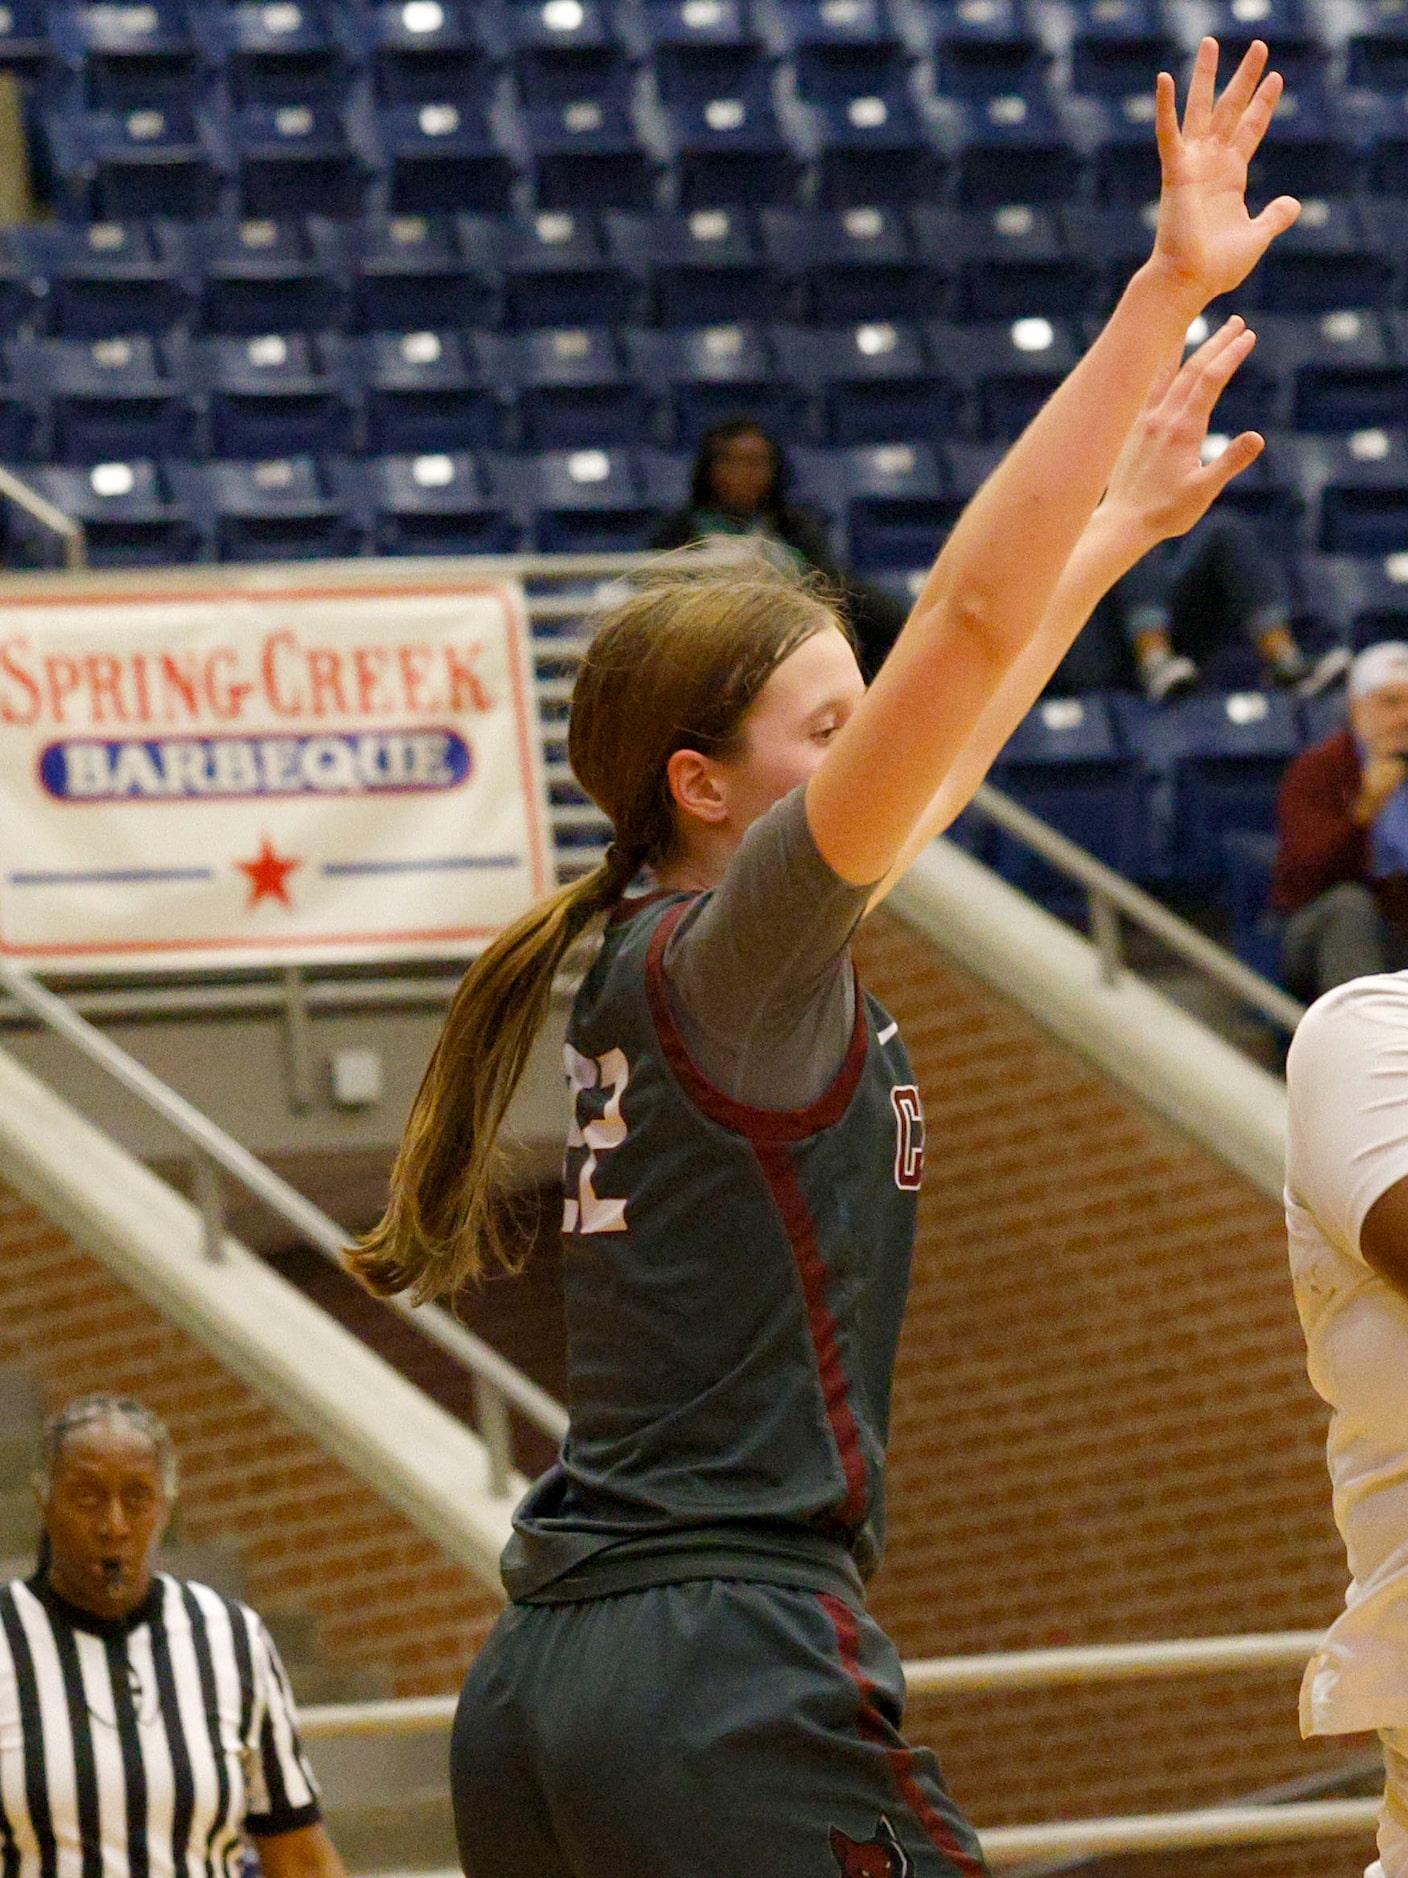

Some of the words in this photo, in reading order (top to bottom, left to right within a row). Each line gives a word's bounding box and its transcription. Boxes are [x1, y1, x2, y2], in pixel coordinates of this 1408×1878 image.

[0, 633, 253, 728] SPRING
[261, 628, 496, 718] CREEK
[63, 733, 456, 797] BARBEQUE
